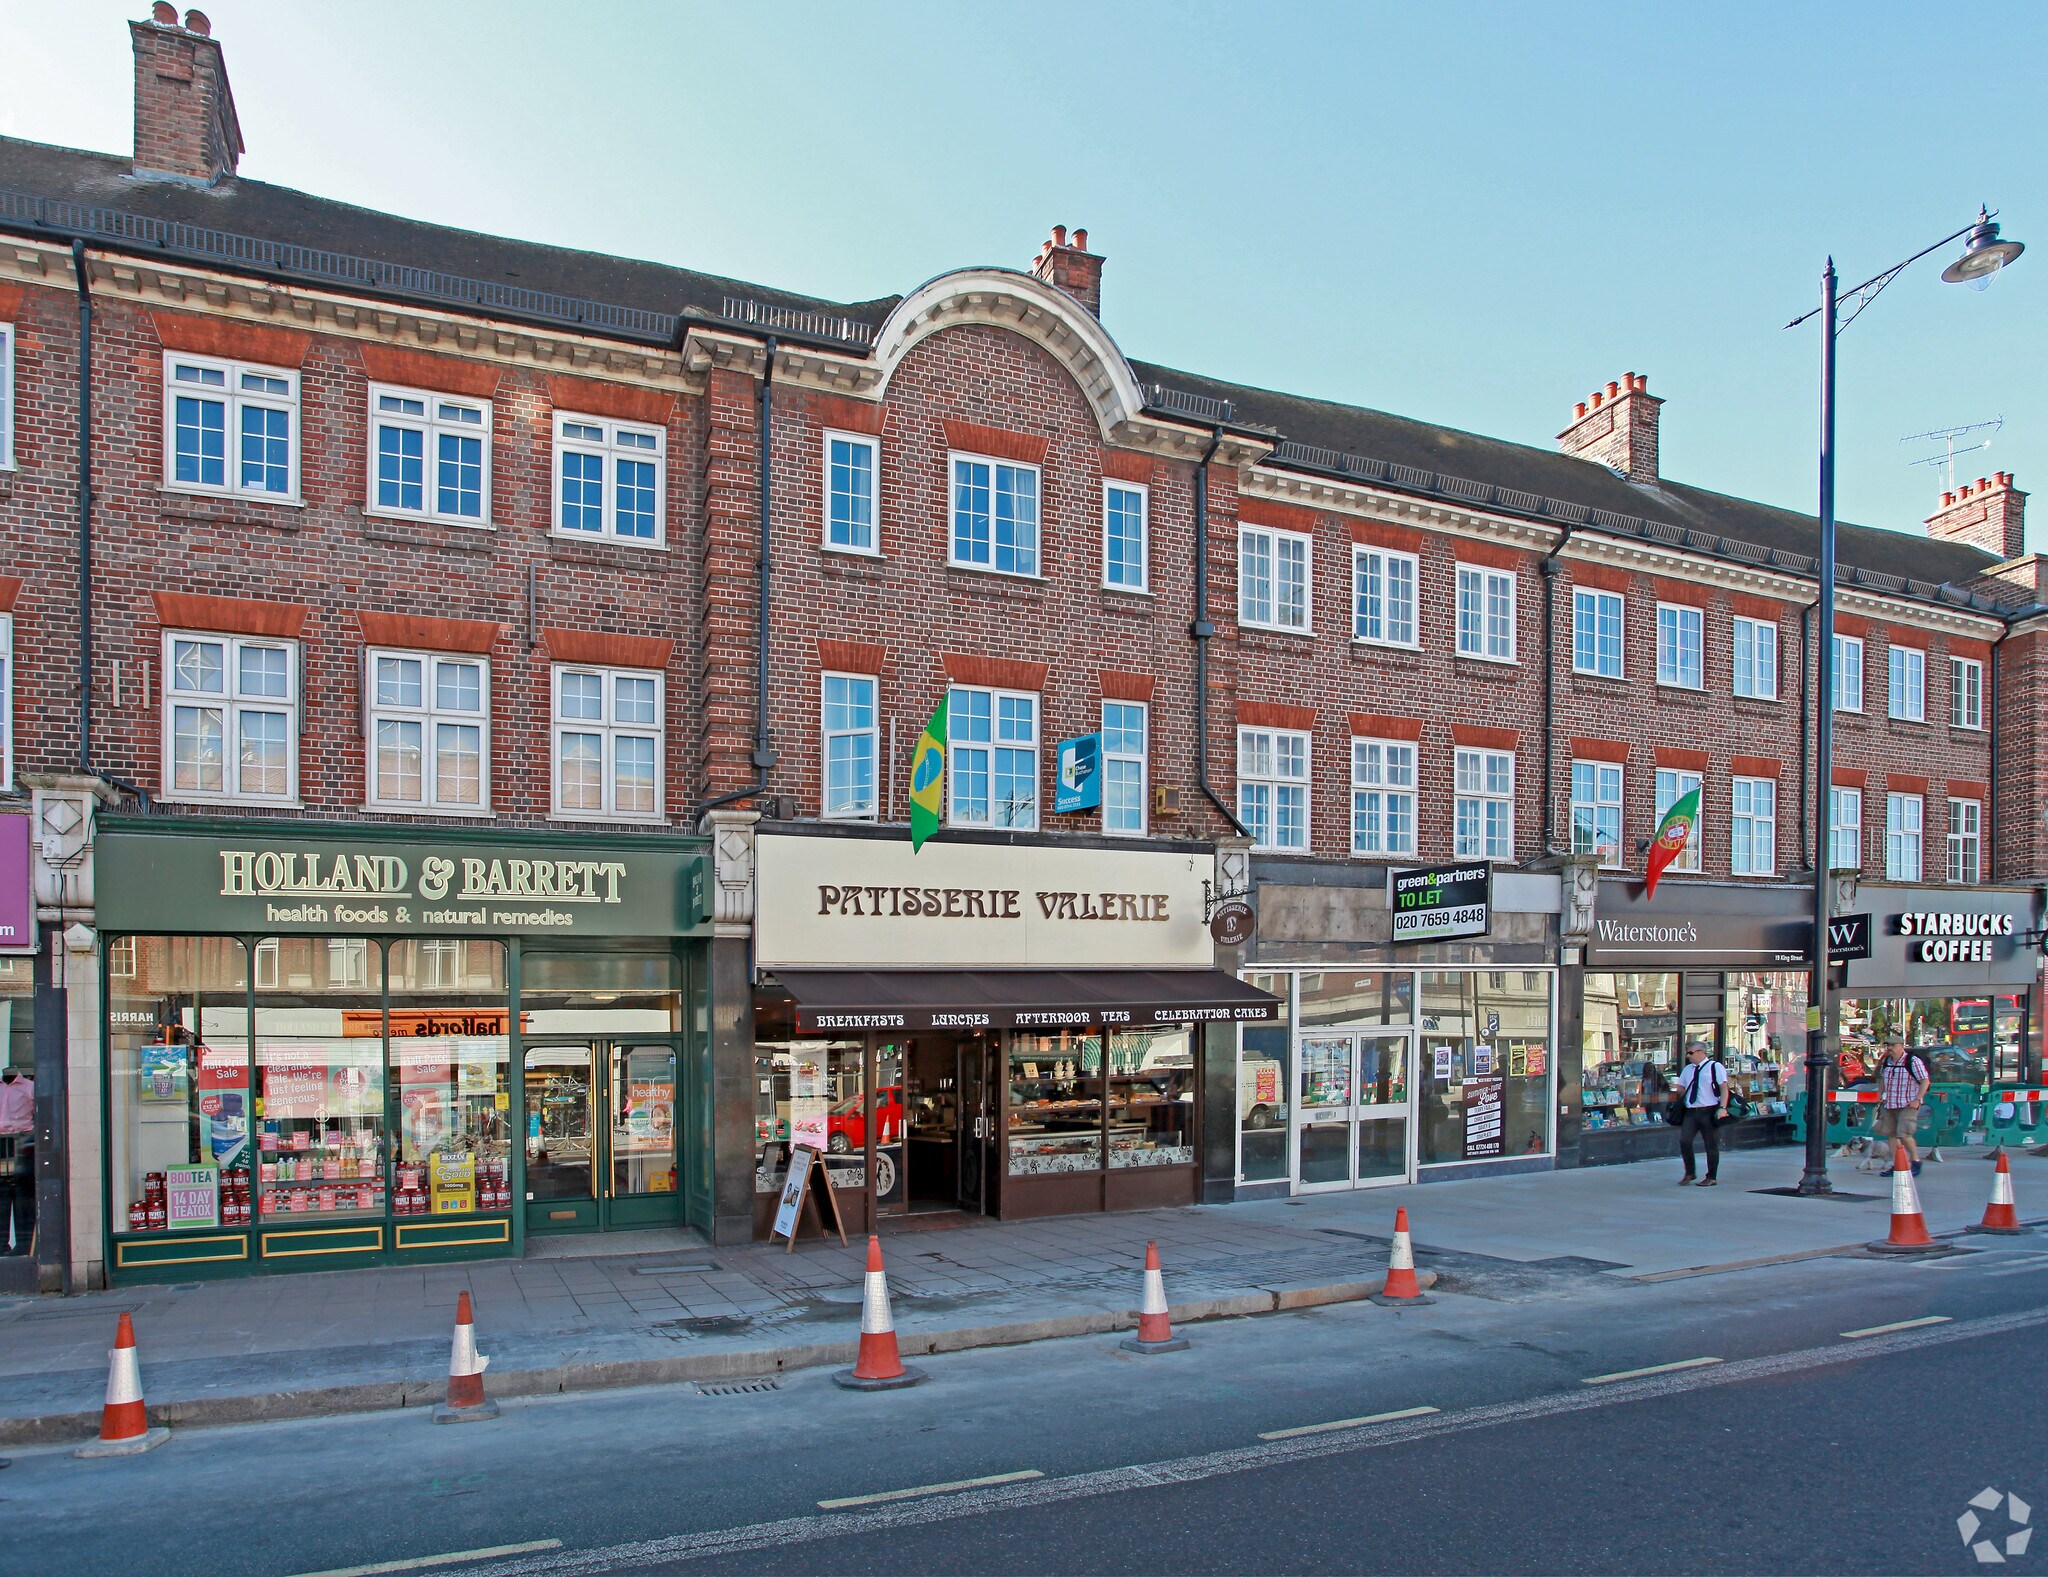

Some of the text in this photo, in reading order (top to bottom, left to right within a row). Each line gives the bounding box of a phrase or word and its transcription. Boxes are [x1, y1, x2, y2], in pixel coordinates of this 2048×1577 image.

[1057, 795, 1081, 806] Success
[220, 851, 626, 903] HOLLAND & BARRETT
[1397, 868, 1486, 892] green&partners
[817, 885, 1170, 922] PATISSERIE VALERIE
[1399, 889, 1443, 908] TO LET
[267, 903, 573, 926] health foods & natural remedies
[1216, 904, 1248, 920] PATISSERIE
[1396, 908, 1484, 930] 020 7659 4848
[1597, 919, 1697, 942] Waterstone's
[1900, 912, 2013, 936] STARBUCKS
[1220, 932, 1244, 943] VALERIE
[1828, 922, 1860, 945] W
[1921, 940, 1993, 962] COFFEE
[816, 1007, 1267, 1028] BREAKFASTS LUNCHES AFTERNOON TEAS CELEBRATION CAKES
[216, 1069, 239, 1079] Sale
[267, 1062, 313, 1073] clearance
[416, 1065, 436, 1074] Sale
[268, 1071, 322, 1084] sale. We're
[269, 1082, 323, 1096] just feeling
[269, 1094, 319, 1106] generous.
[170, 1171, 212, 1184] BOOTEA
[441, 1171, 471, 1181] GOLD
[174, 1190, 211, 1206] 14 DAY
[174, 1204, 211, 1217] TEATOX
